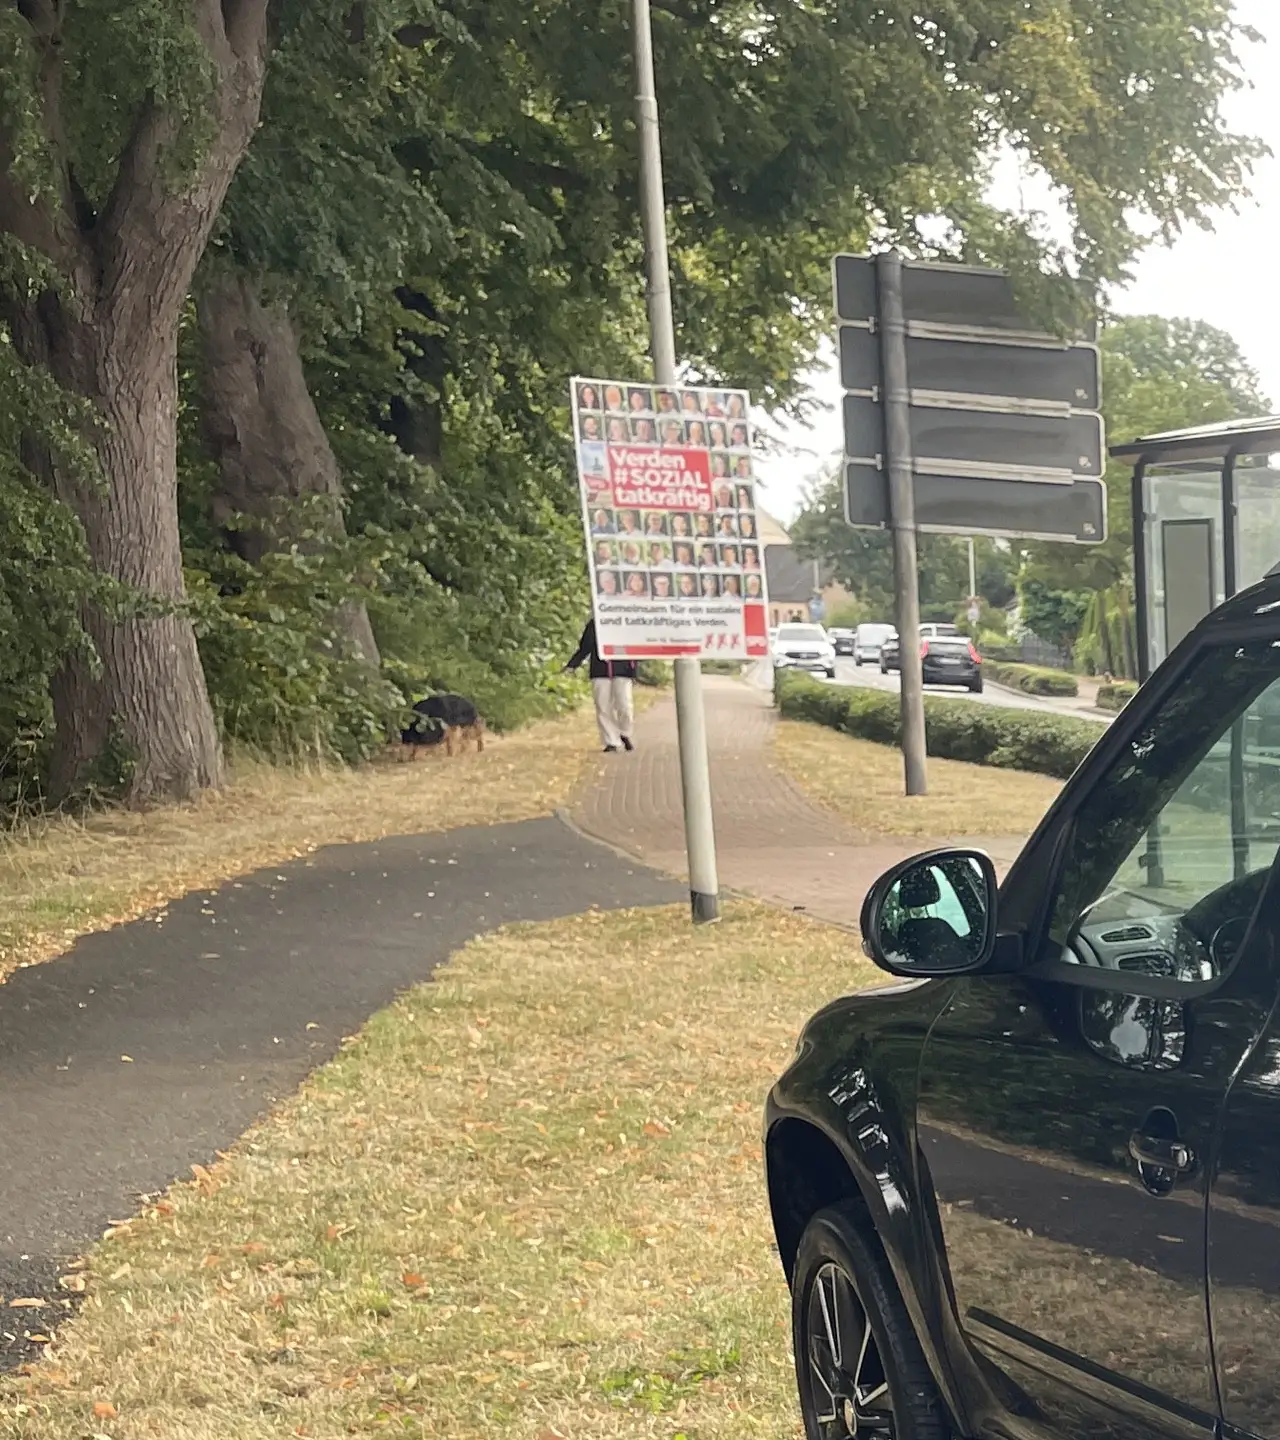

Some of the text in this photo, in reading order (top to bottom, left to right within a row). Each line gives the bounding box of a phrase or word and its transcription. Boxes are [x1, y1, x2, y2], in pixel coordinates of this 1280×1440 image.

[610, 448, 686, 470] Verden
[614, 467, 708, 489] #SOZIAL
[614, 486, 711, 512] tatkräftig
[599, 617, 622, 626] und
